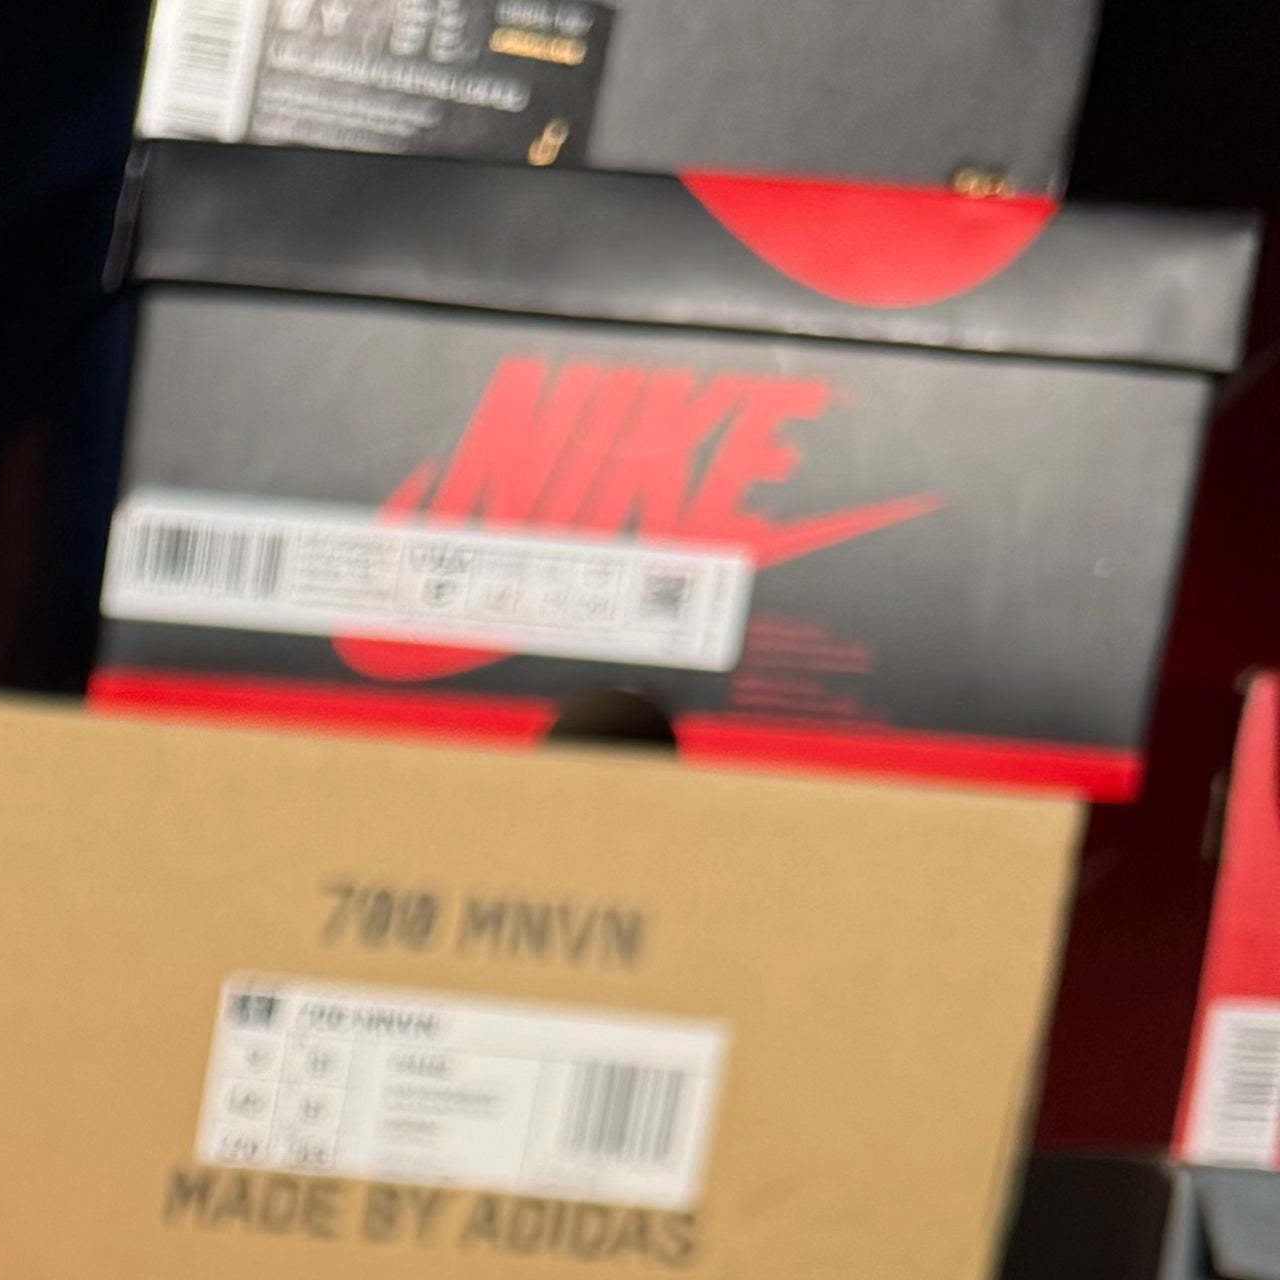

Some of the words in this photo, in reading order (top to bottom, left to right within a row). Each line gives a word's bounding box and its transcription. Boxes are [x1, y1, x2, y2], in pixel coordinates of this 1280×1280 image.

[423, 355, 832, 552] NIKE
[318, 878, 438, 953] 700
[455, 893, 649, 975] MNVN
[163, 1167, 341, 1240] MADE
[359, 1178, 444, 1247] BY
[458, 1190, 700, 1269] ADIDAS
